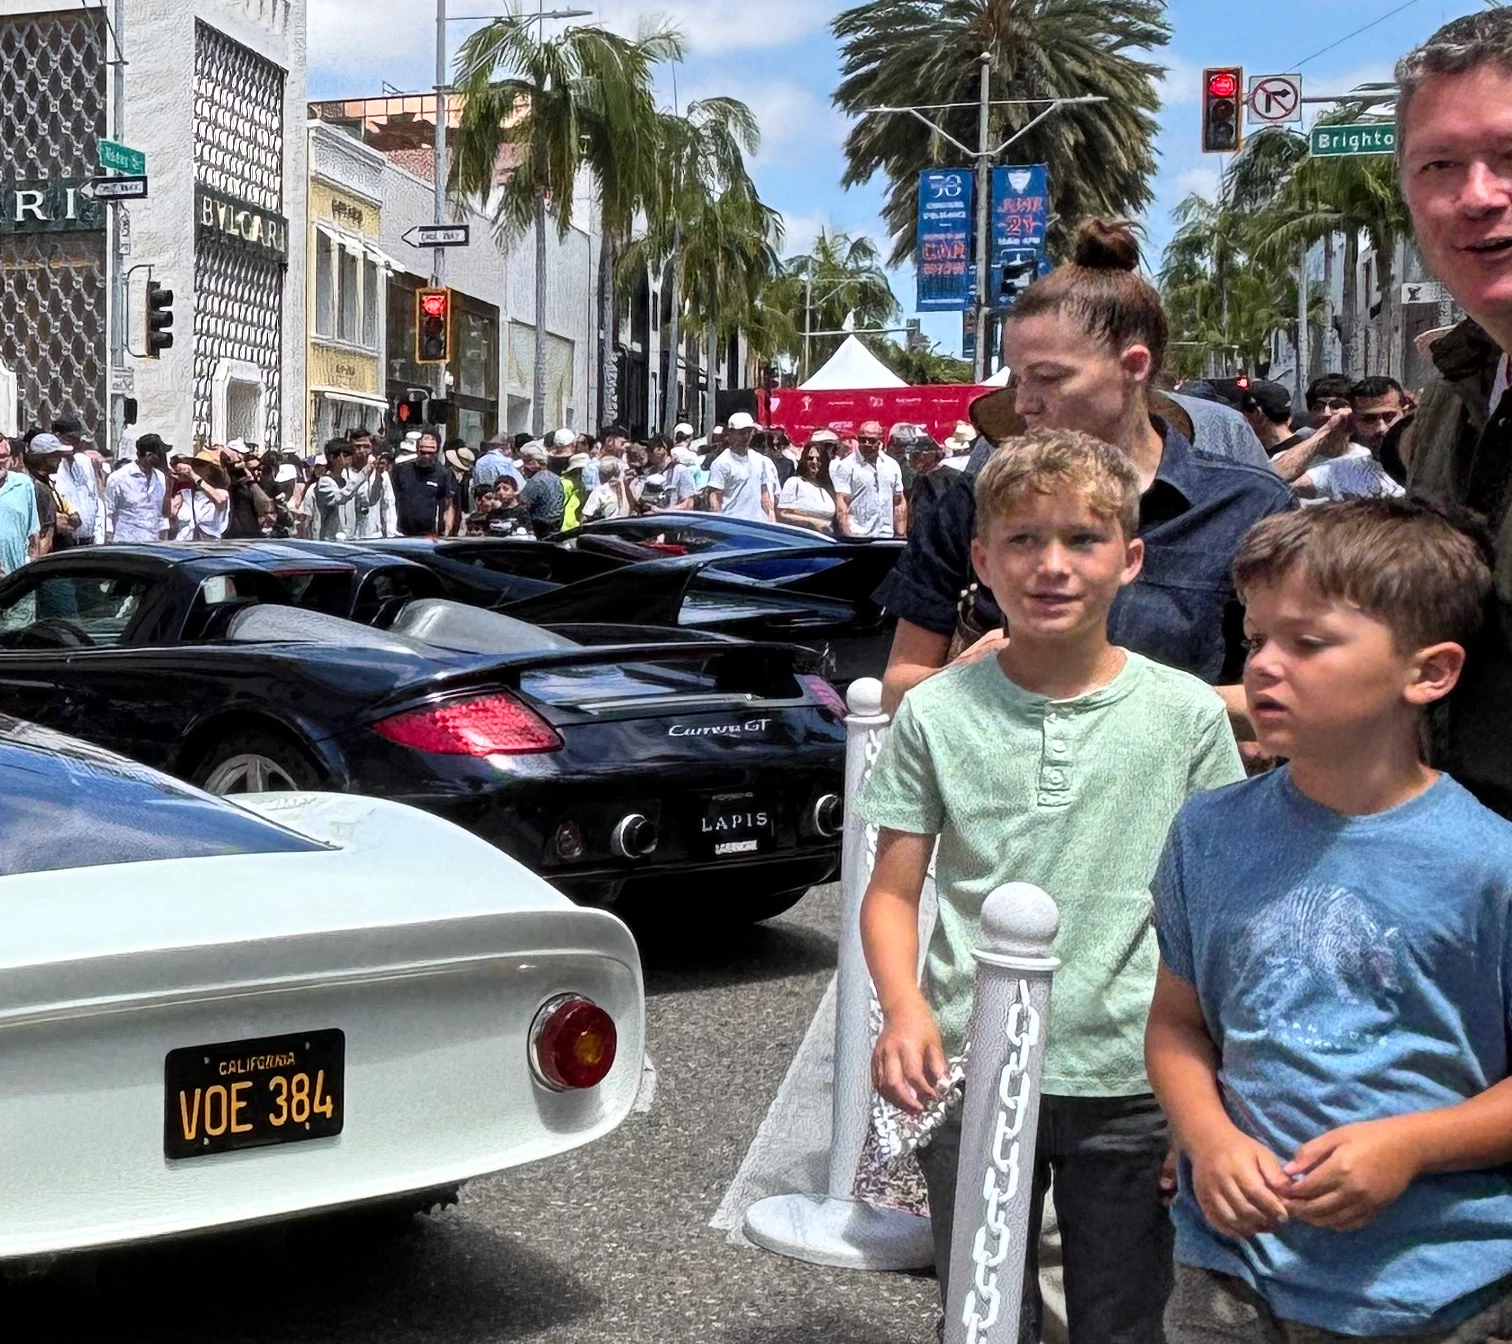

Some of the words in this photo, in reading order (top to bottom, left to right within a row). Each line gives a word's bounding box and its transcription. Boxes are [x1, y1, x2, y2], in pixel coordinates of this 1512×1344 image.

[1319, 132, 1394, 151] Brighto
[201, 195, 285, 253] BVLGARI
[701, 811, 768, 833] LAPIS
[219, 1051, 296, 1076] CALIFORNIA
[179, 1080, 254, 1141] VOE
[268, 1069, 334, 1127] 384
